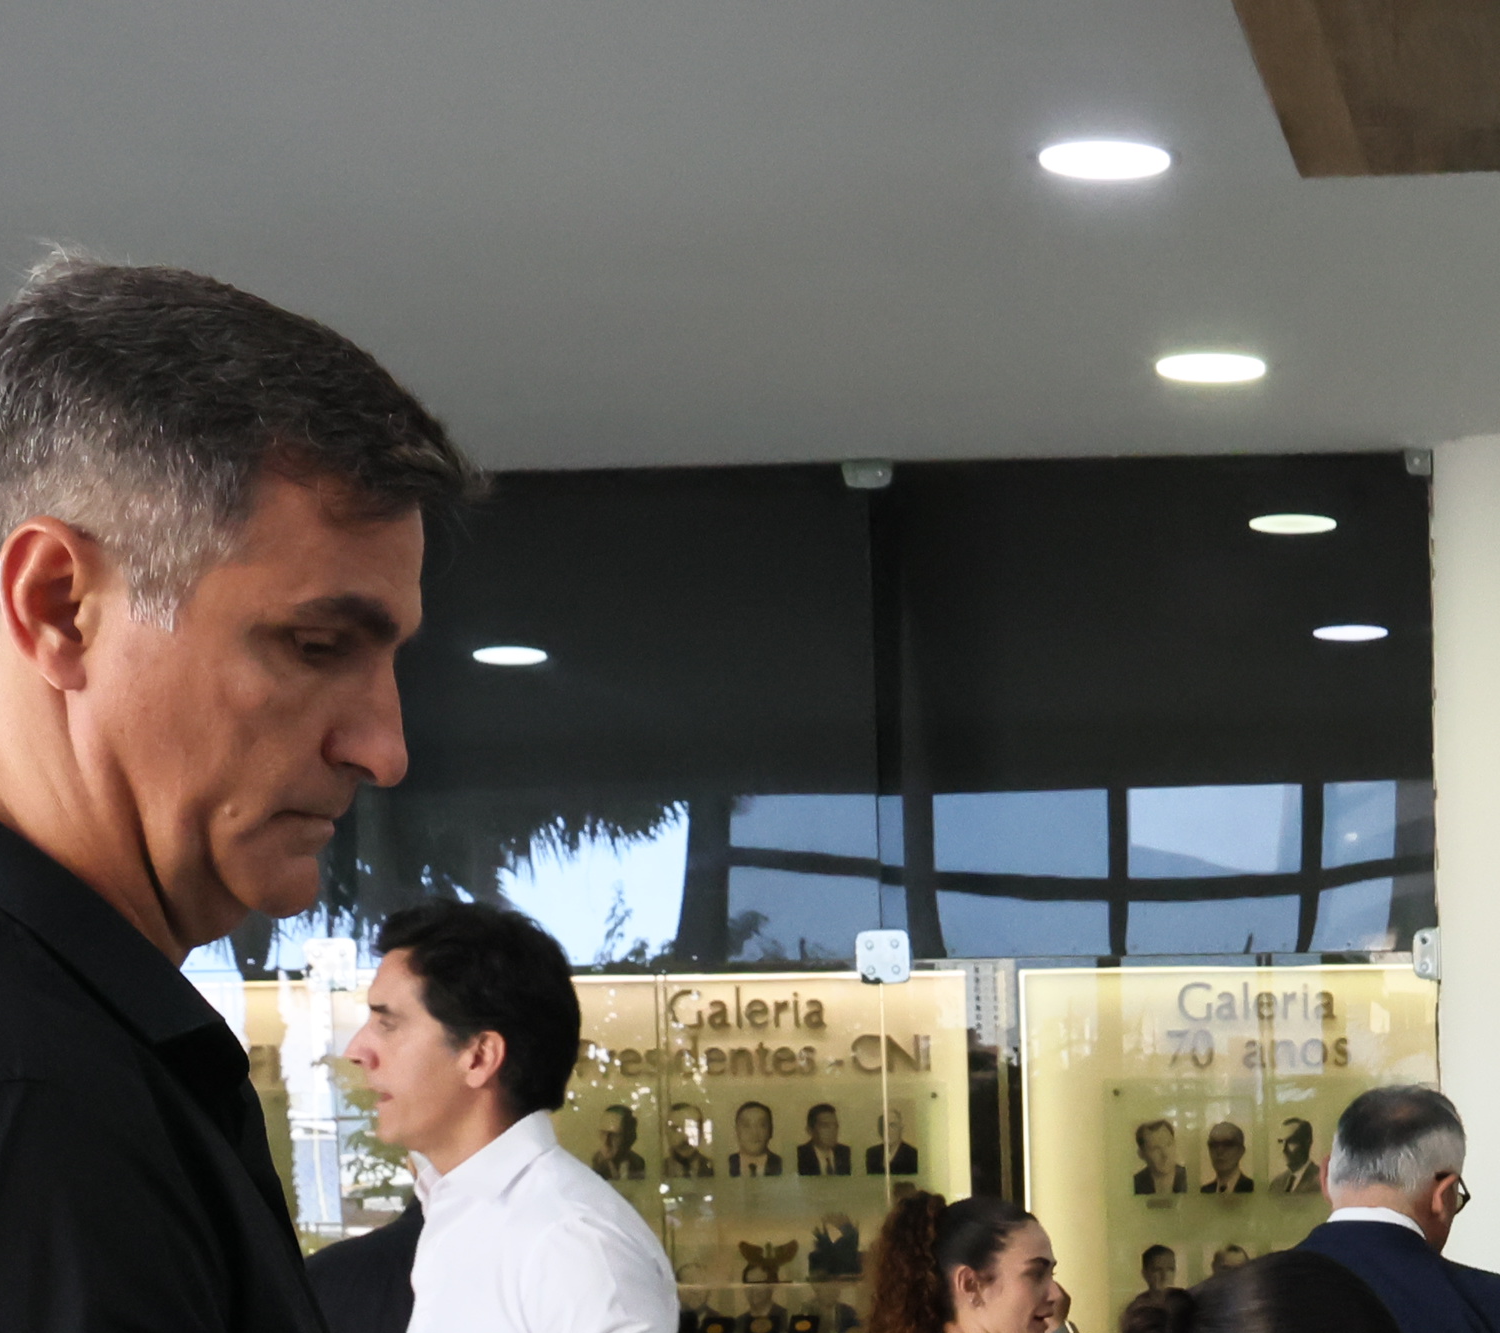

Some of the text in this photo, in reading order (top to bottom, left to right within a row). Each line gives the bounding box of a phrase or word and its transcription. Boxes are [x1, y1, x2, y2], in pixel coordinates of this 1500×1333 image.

[668, 989, 828, 1032] Galeria
[1177, 981, 1336, 1023] Galeria
[1166, 1029, 1352, 1070] 70 anos
